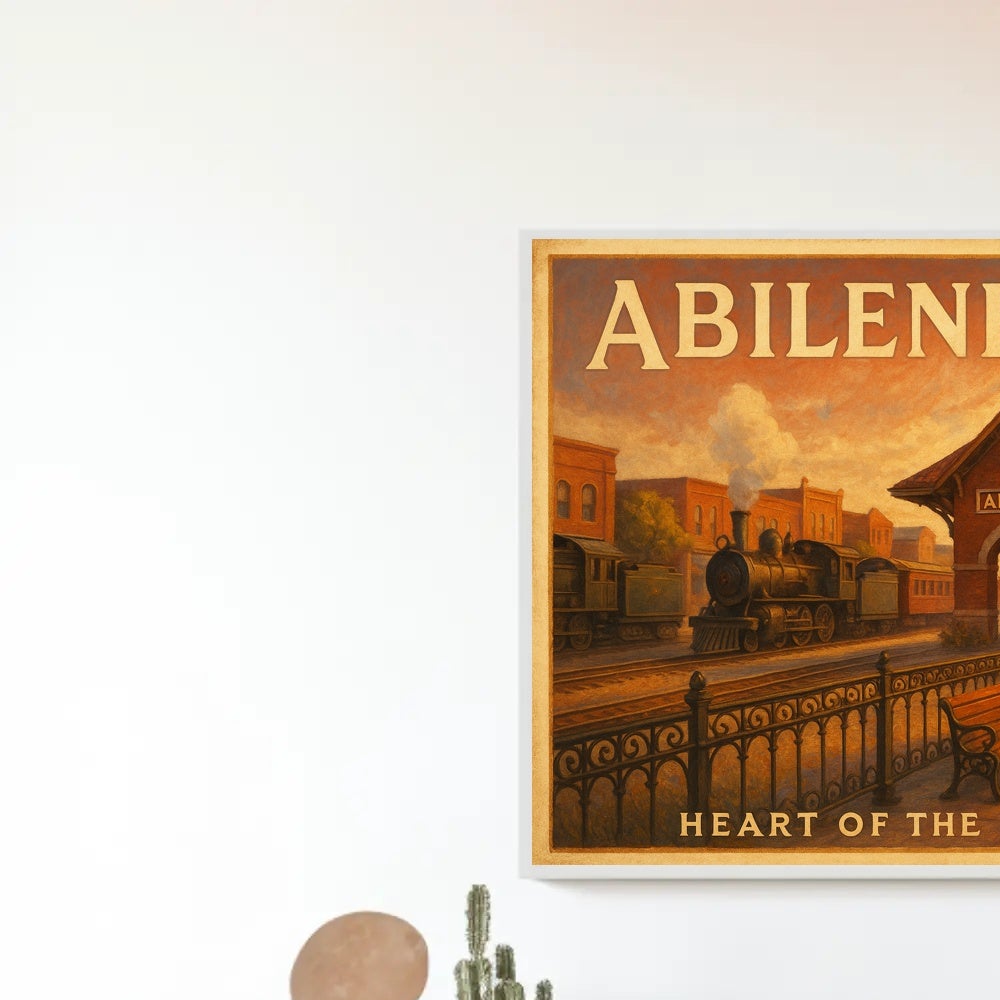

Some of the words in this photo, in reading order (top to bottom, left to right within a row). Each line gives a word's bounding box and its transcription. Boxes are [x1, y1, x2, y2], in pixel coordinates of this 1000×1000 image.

[679, 811, 819, 837] HEART
[838, 811, 888, 837] OF
[906, 811, 980, 837] THE
